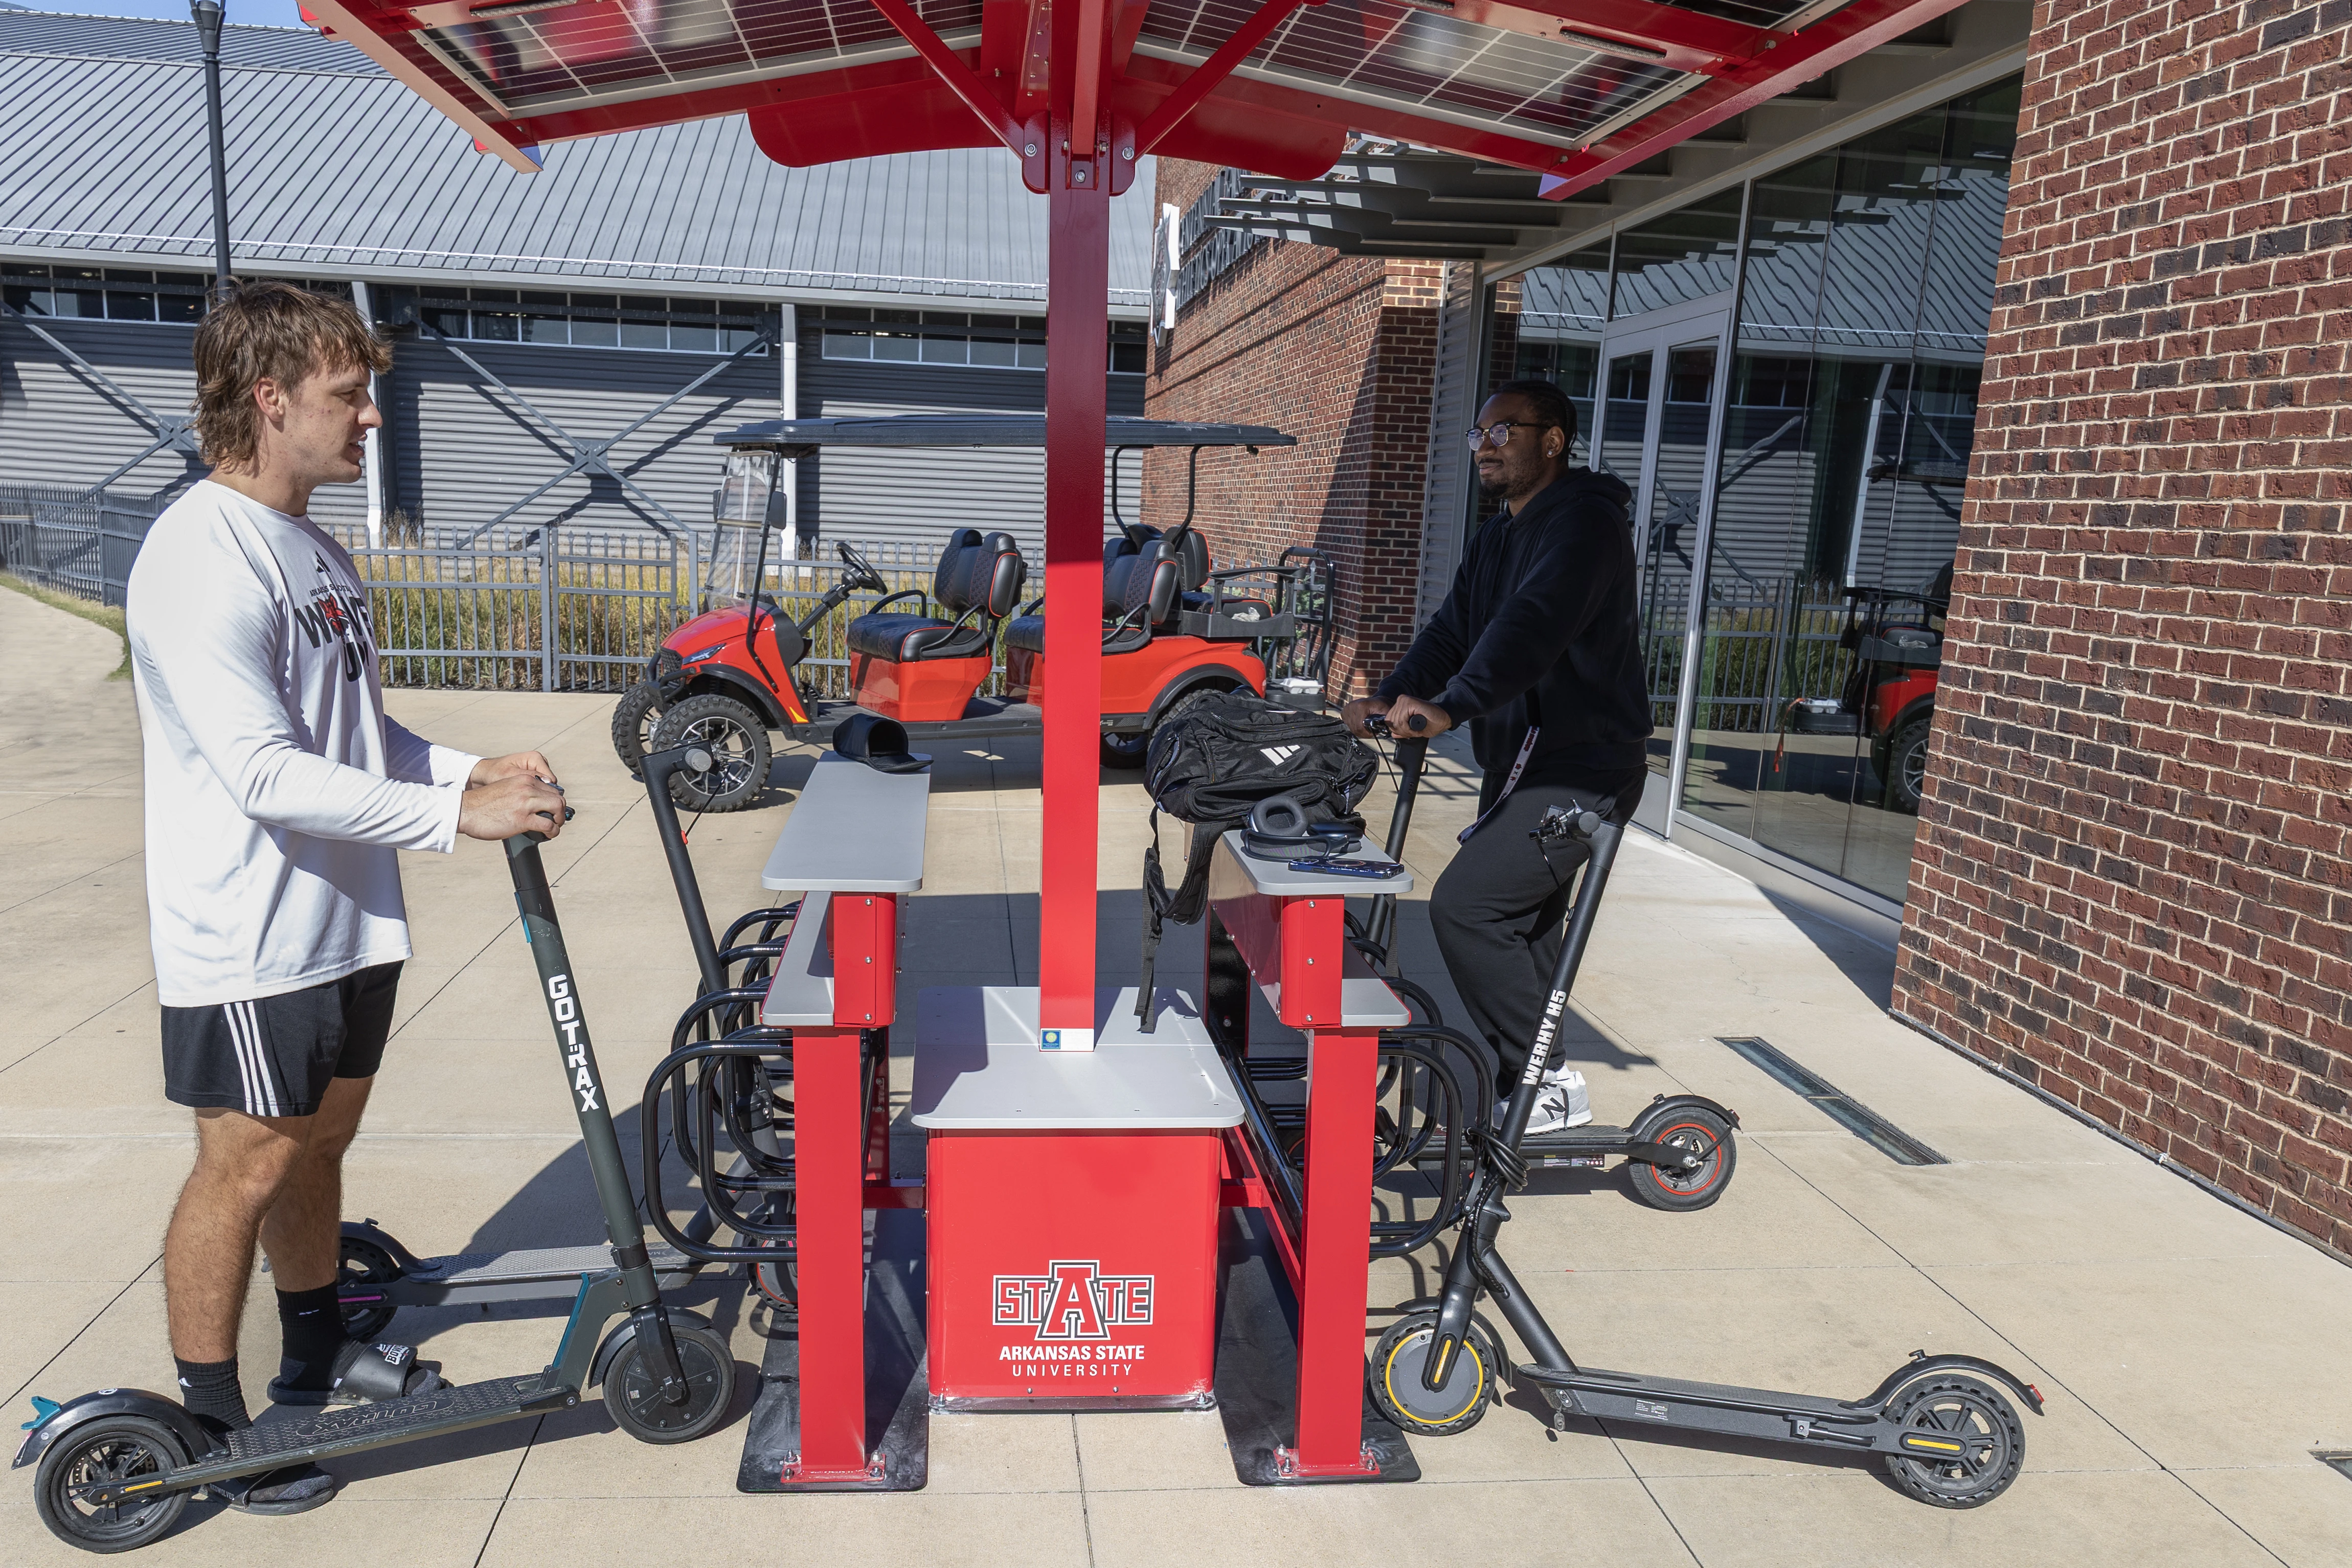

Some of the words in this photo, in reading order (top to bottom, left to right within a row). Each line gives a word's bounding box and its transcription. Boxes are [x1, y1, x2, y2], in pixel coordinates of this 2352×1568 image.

[548, 974, 600, 1112] GOTRAX
[1522, 1017, 1557, 1085] WERHY
[1546, 989, 1567, 1017] H5
[993, 1260, 1154, 1340] STATE
[999, 1345, 1091, 1360] ARKANSAS
[1096, 1345, 1145, 1360] STATE
[1012, 1364, 1132, 1377] UNIVERSITY
[312, 1401, 438, 1435] GOTRAX
